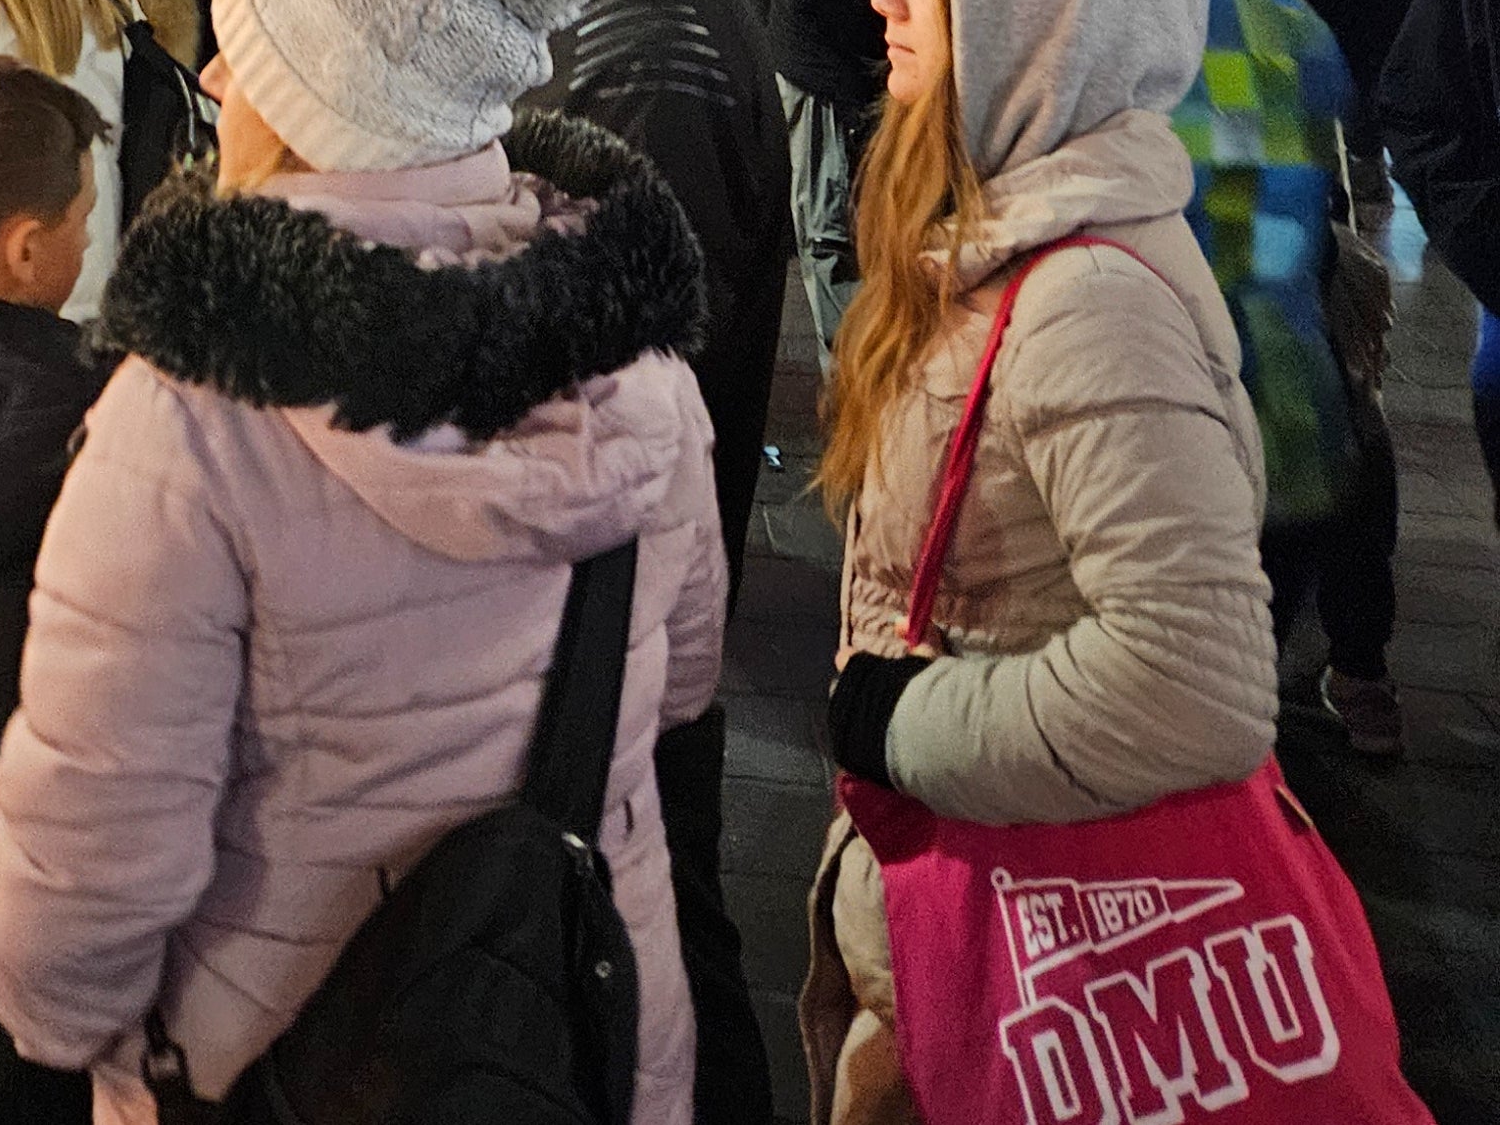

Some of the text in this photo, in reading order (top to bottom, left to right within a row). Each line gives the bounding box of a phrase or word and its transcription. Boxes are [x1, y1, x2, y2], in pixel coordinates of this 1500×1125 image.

[1015, 889, 1157, 961] EST. 1870
[999, 913, 1342, 1125] DMU
